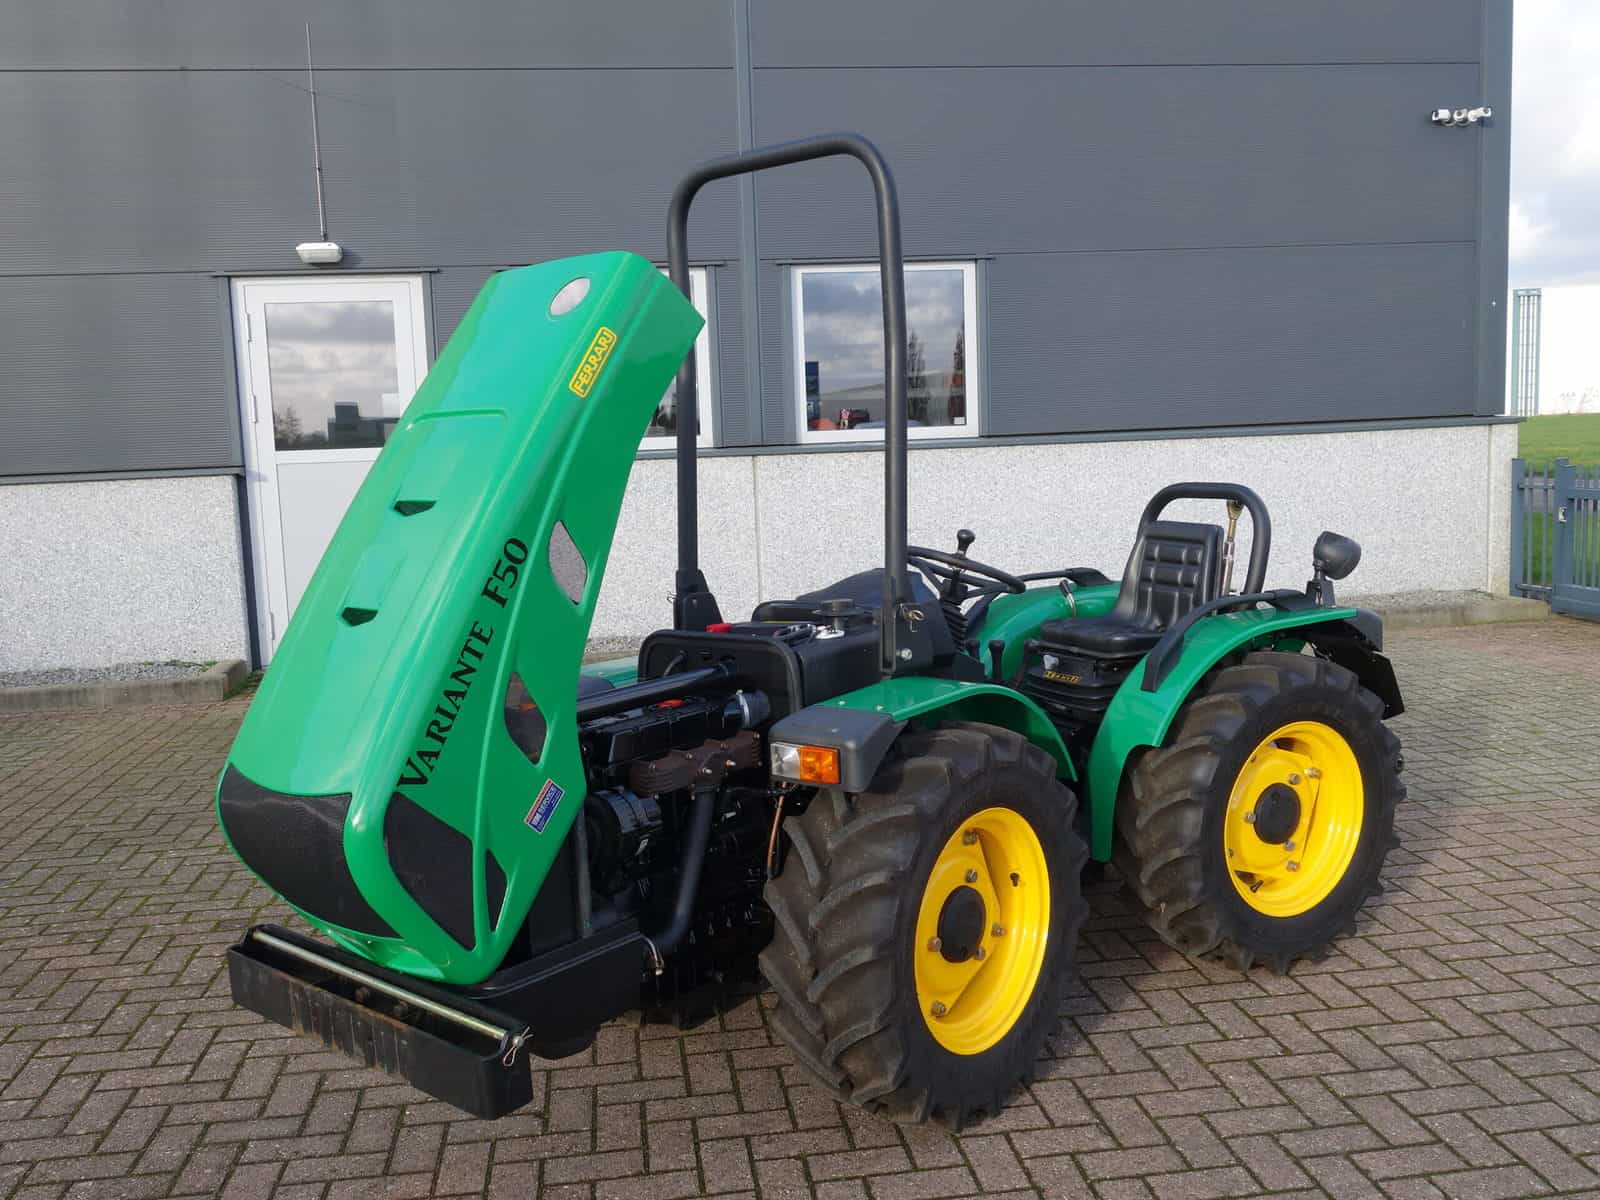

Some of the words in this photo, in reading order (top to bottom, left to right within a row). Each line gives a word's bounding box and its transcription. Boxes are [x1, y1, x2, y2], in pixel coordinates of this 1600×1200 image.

[573, 330, 613, 394] FERRARI
[396, 620, 494, 787] VARIANTE
[481, 537, 529, 608] F50
